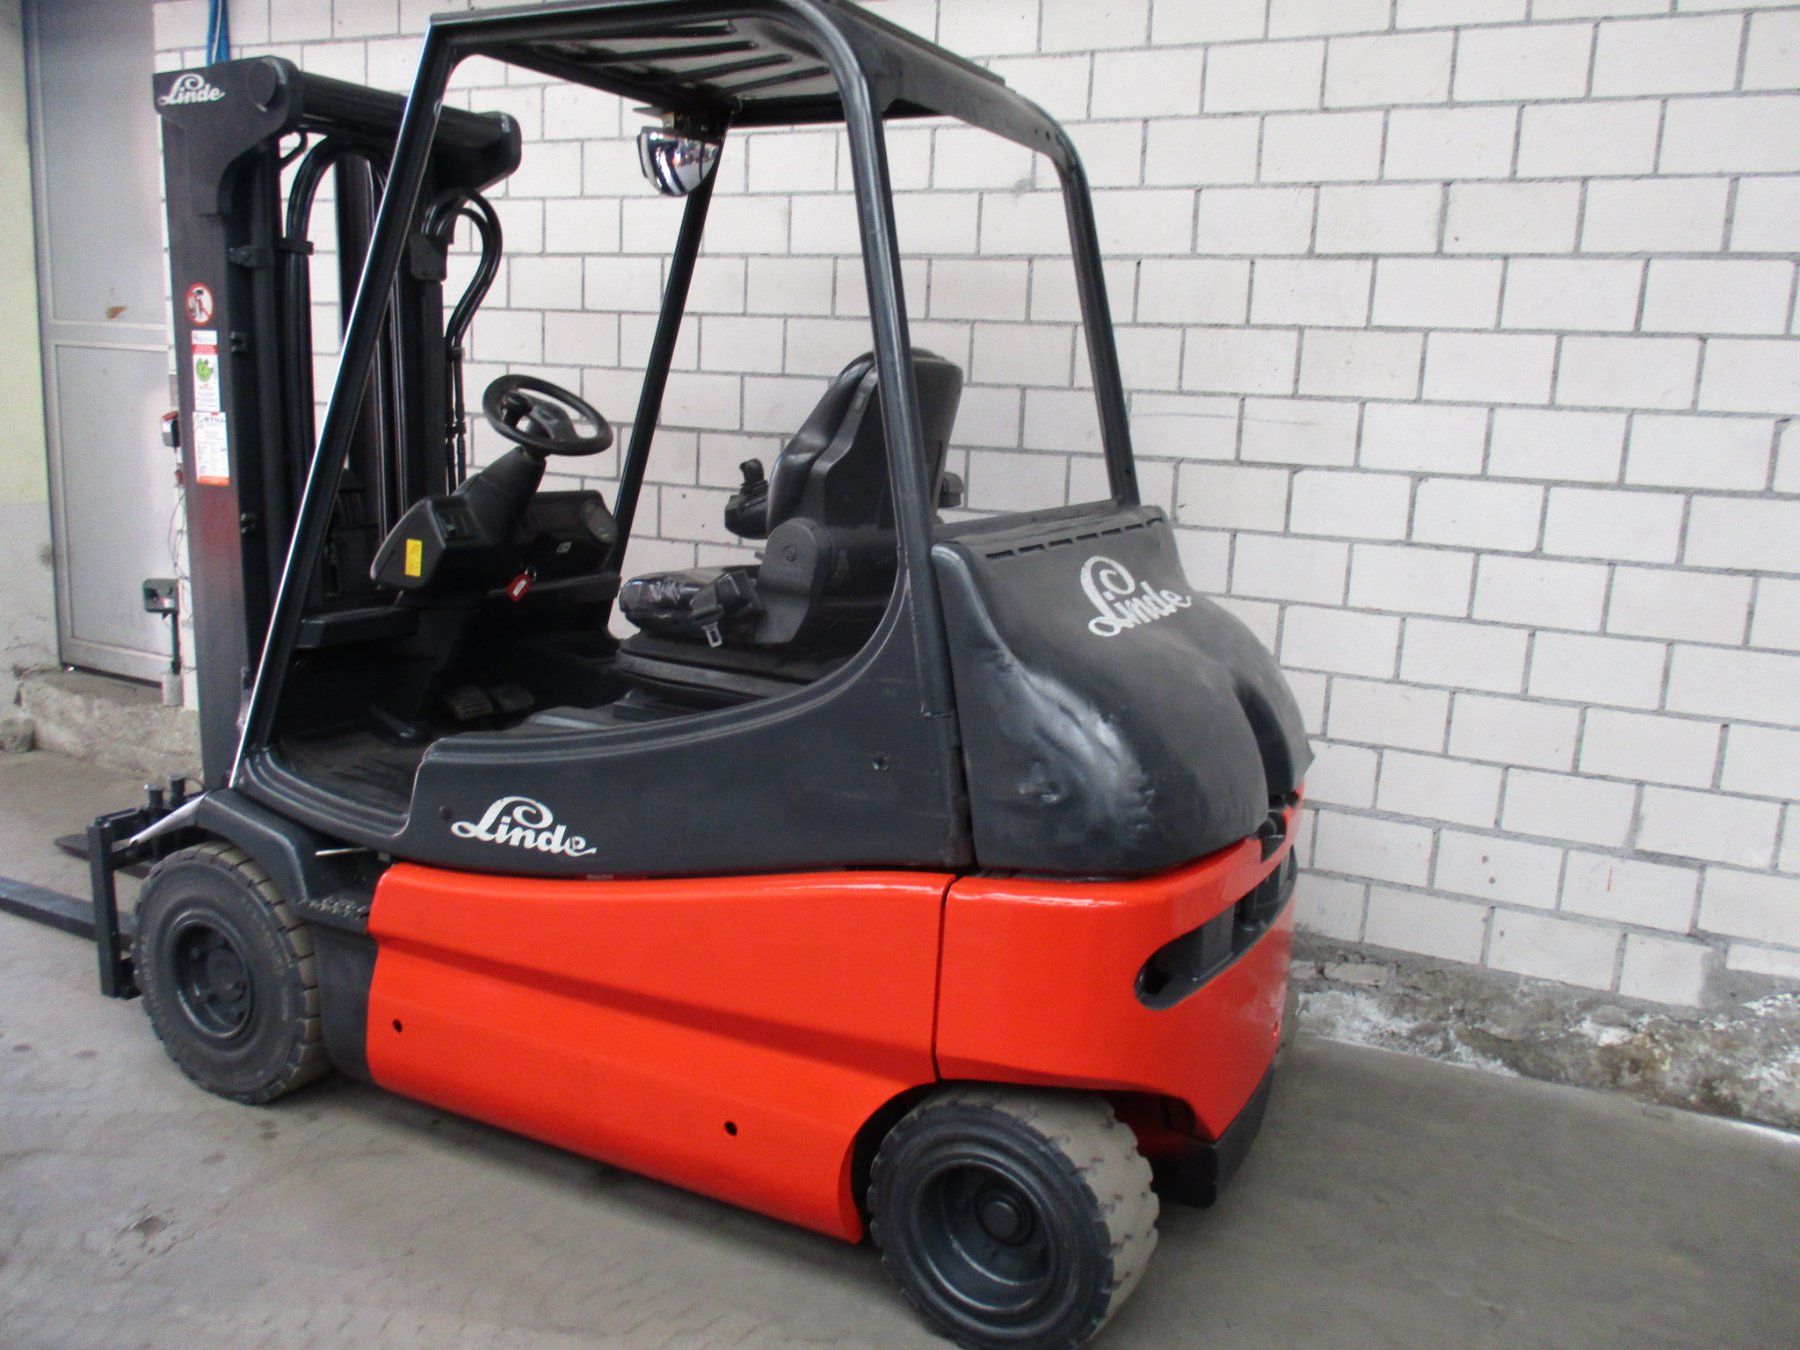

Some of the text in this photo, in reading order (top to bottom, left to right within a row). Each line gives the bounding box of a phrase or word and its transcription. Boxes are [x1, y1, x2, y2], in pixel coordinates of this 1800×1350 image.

[157, 73, 226, 106] Linde
[1080, 556, 1192, 637] Linde
[451, 796, 597, 857] Linde
